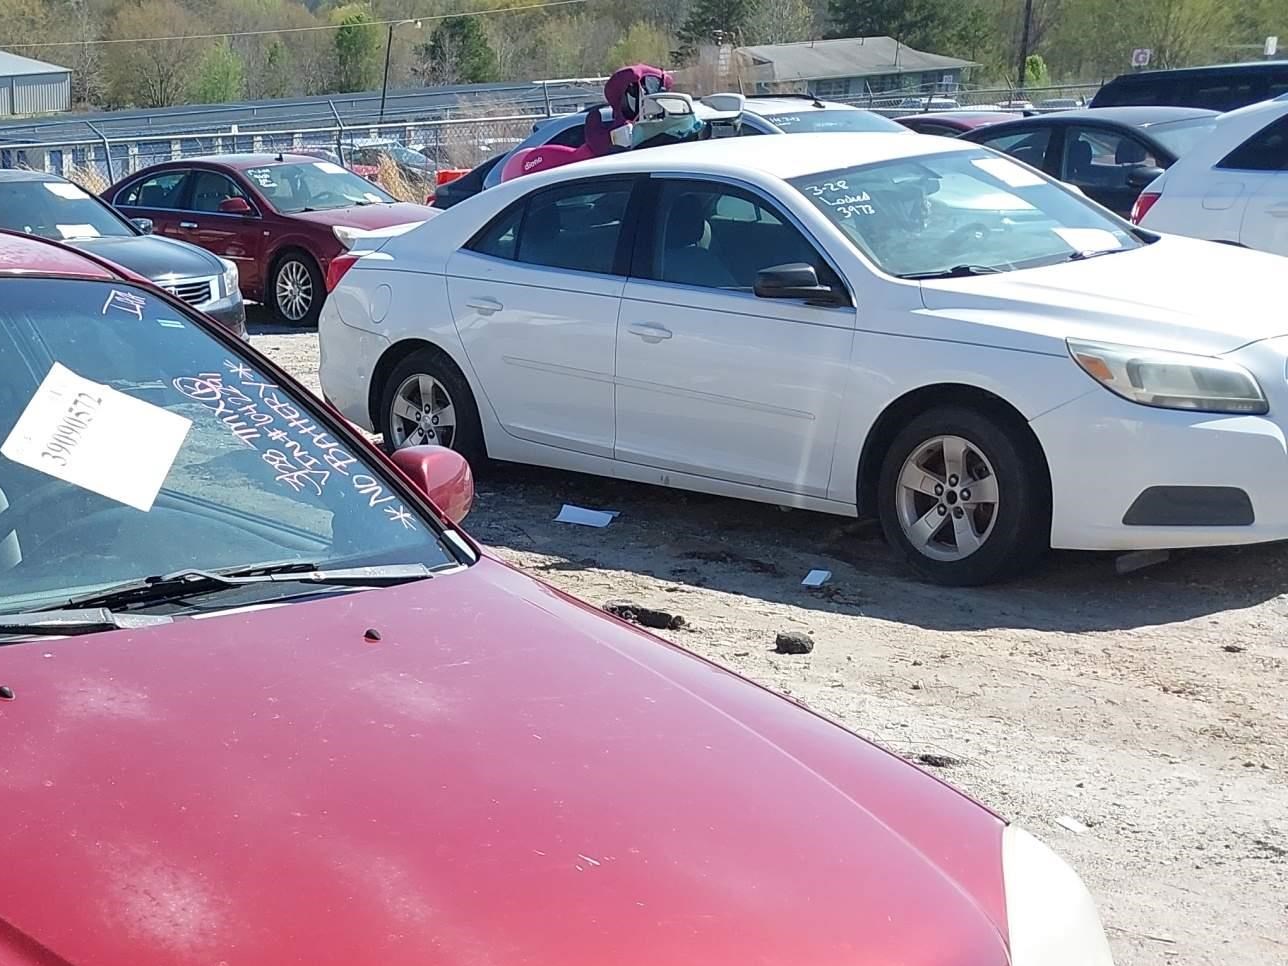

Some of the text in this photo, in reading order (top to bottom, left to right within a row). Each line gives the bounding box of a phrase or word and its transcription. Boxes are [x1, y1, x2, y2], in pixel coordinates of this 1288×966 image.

[804, 180, 849, 196] 3-28
[40, 392, 102, 467] 39090572
[262, 448, 323, 496] 3/28
